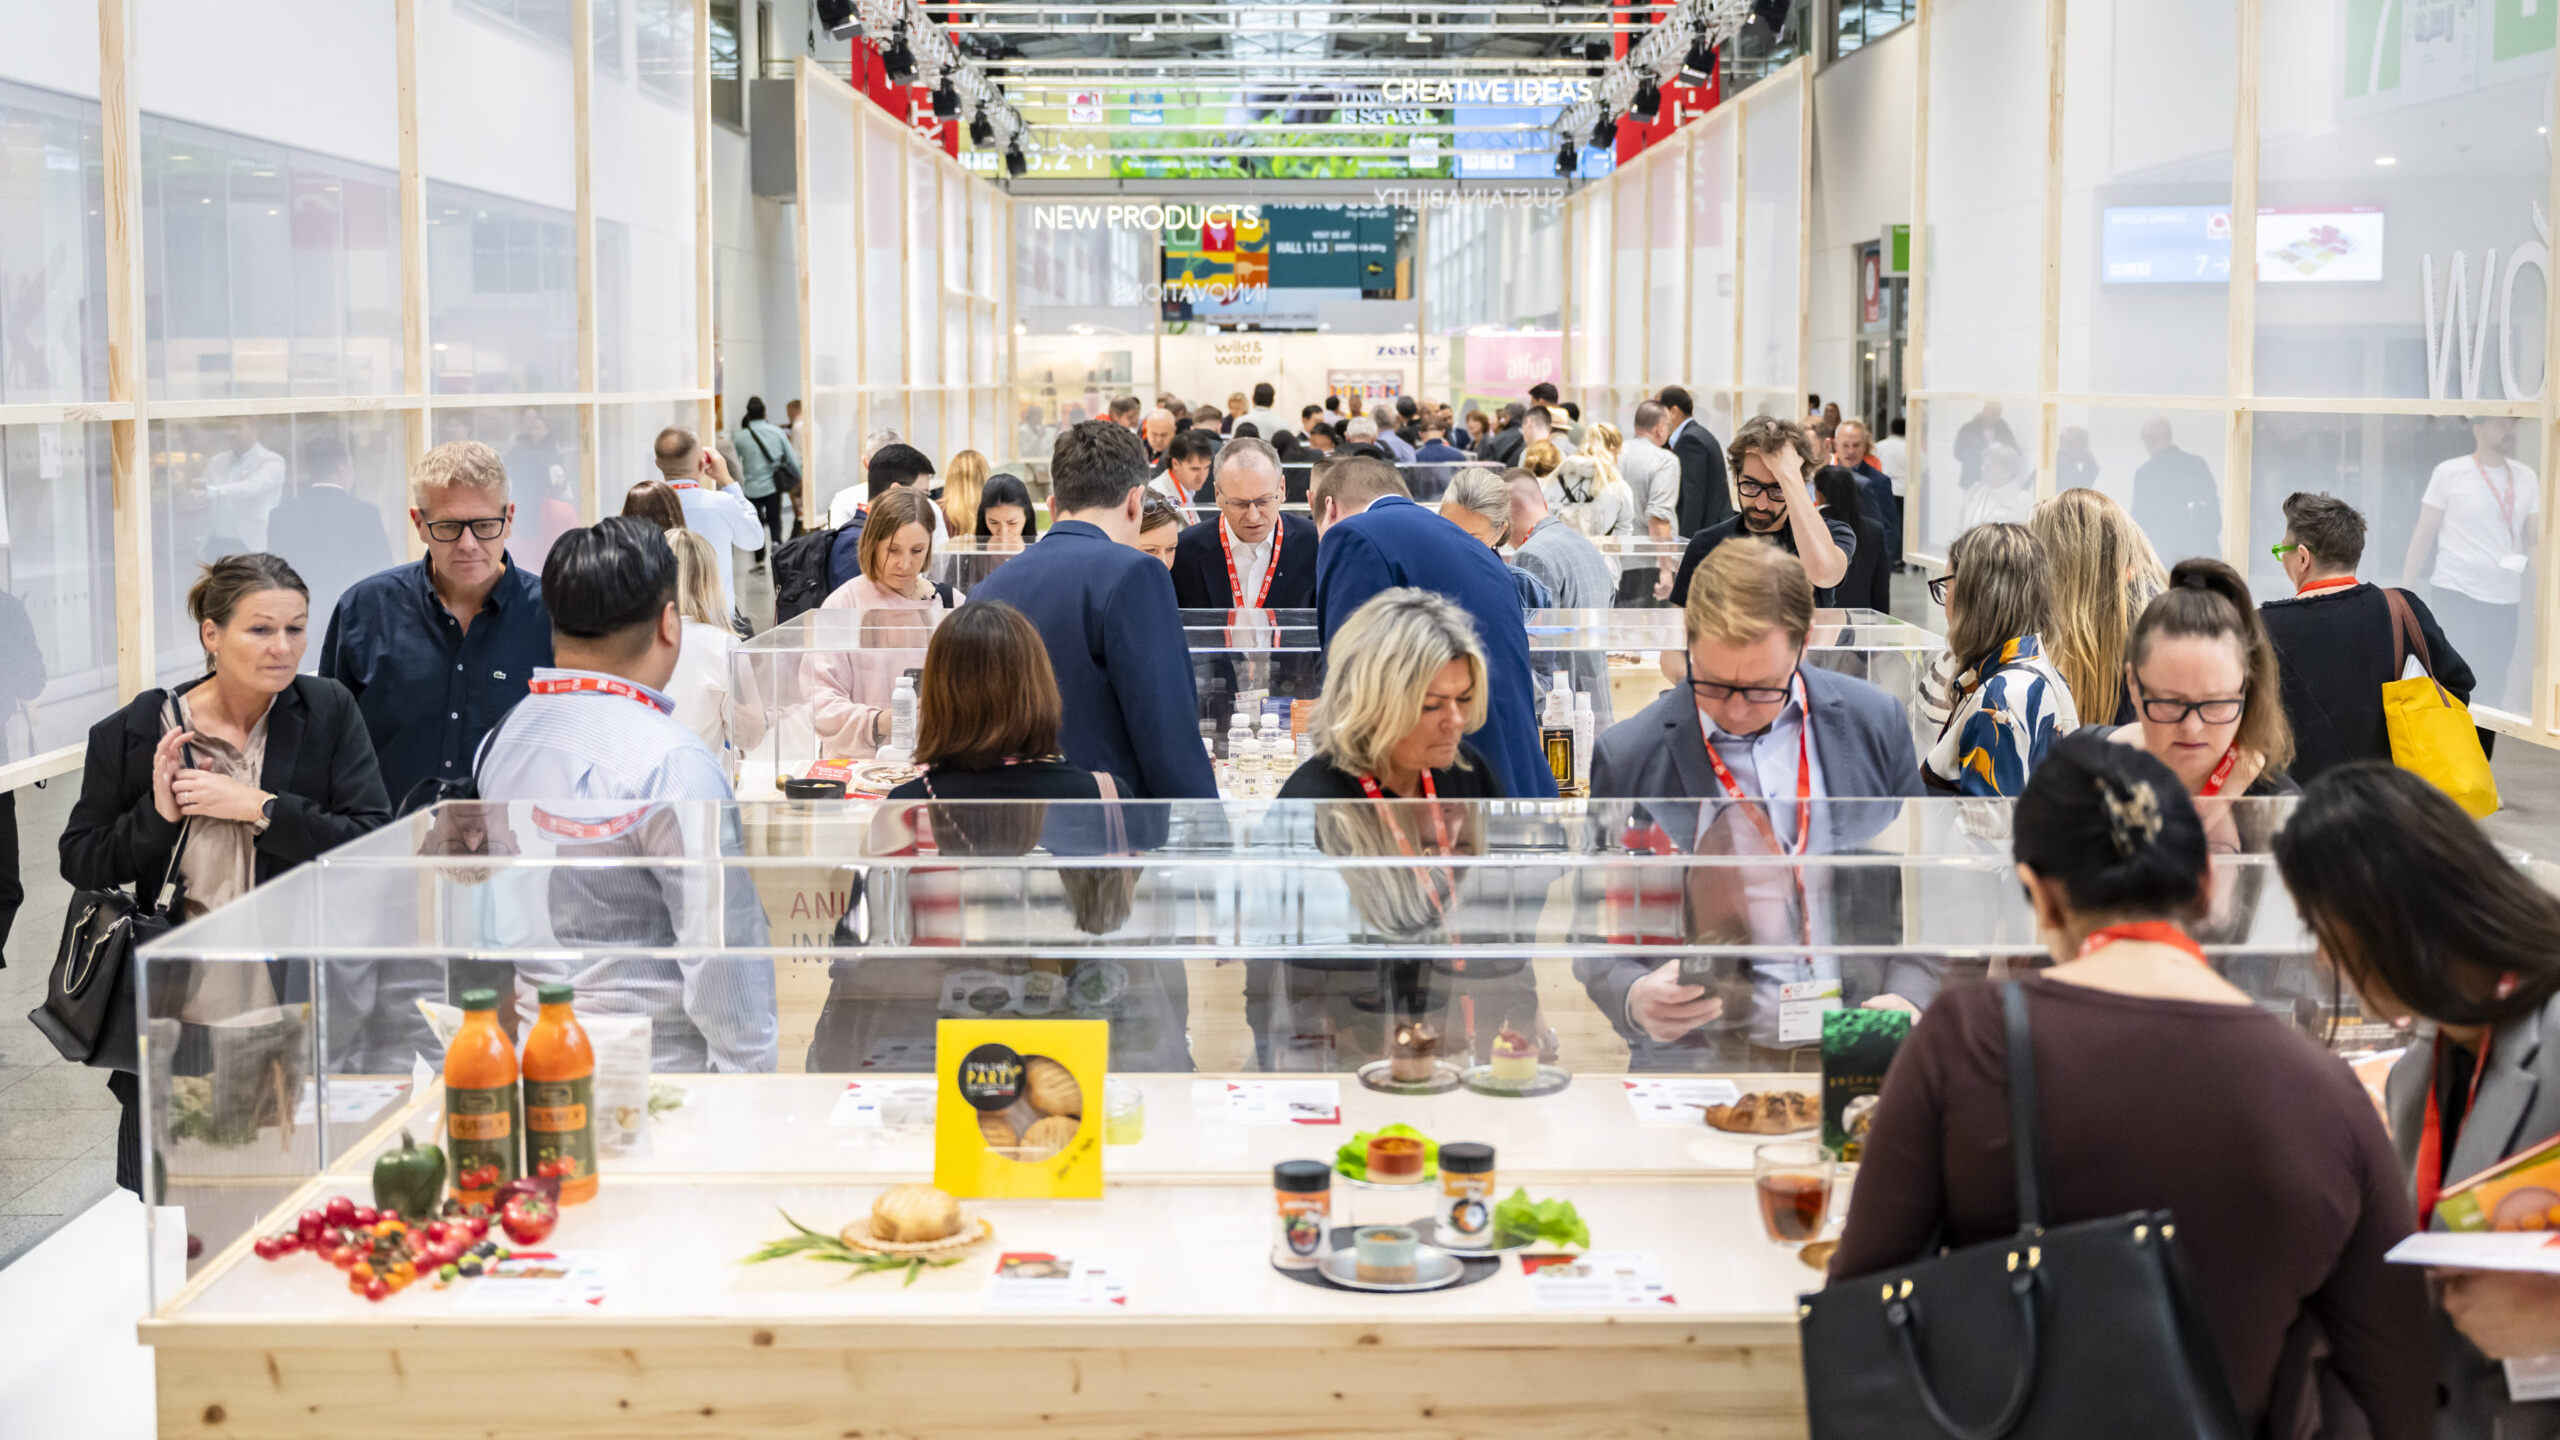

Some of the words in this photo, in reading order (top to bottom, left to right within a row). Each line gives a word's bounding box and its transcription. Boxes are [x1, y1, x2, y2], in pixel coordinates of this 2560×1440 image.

[1382, 77, 1508, 103] CREATIVE
[1513, 79, 1593, 103] IDEAS
[1034, 205, 1101, 230] NEW
[1107, 205, 1260, 230] PRODUCTS
[1276, 242, 1303, 254] HALL
[1306, 242, 1328, 254] 11.3
[1215, 354, 1262, 366] water
[966, 1068, 1018, 1085] PARTY
